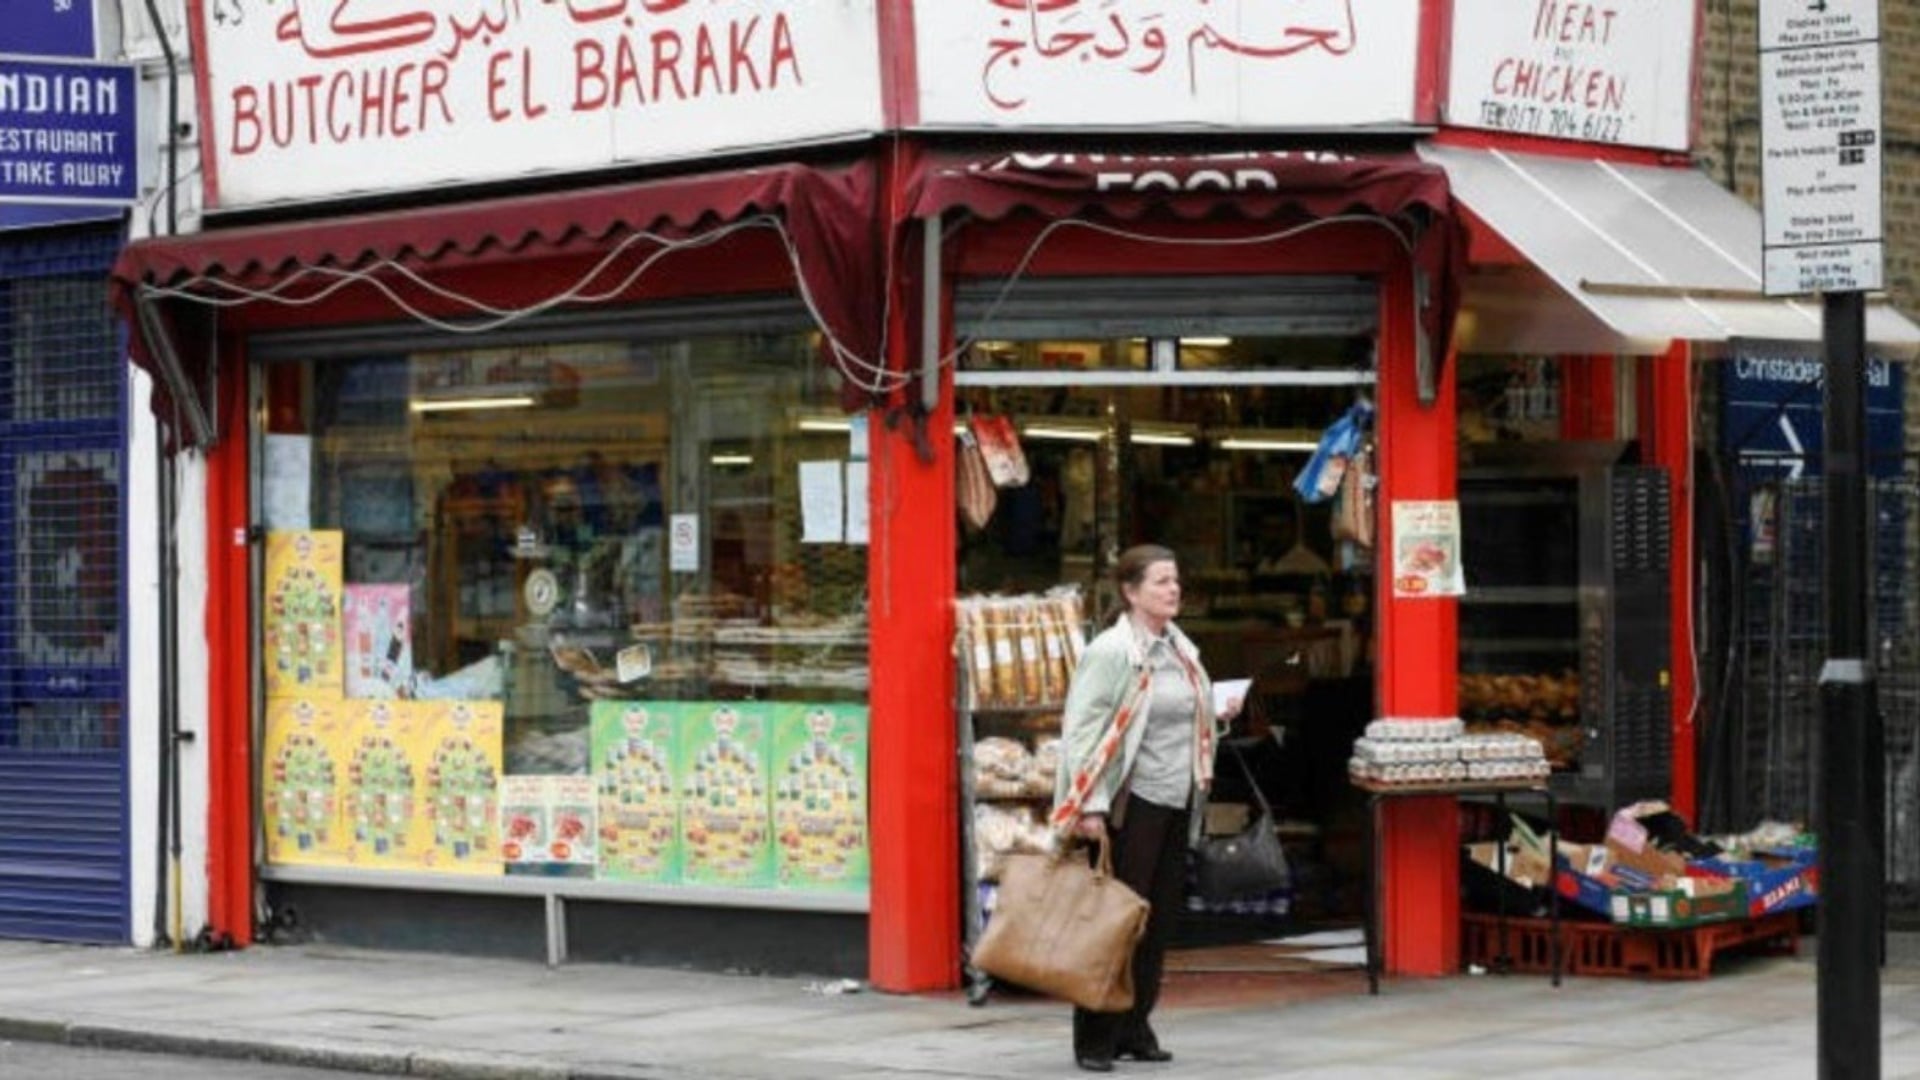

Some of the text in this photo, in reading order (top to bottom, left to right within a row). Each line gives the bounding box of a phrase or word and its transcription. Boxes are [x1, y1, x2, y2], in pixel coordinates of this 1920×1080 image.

[1534, 0, 1617, 44] MEAT
[0, 74, 118, 115] NDIAN
[230, 13, 803, 155] BUTCHER EL BARAKA
[1492, 58, 1627, 111] CHICKEN
[0, 129, 119, 154] ESTAURANT
[1, 161, 124, 188] TAKE AWAY
